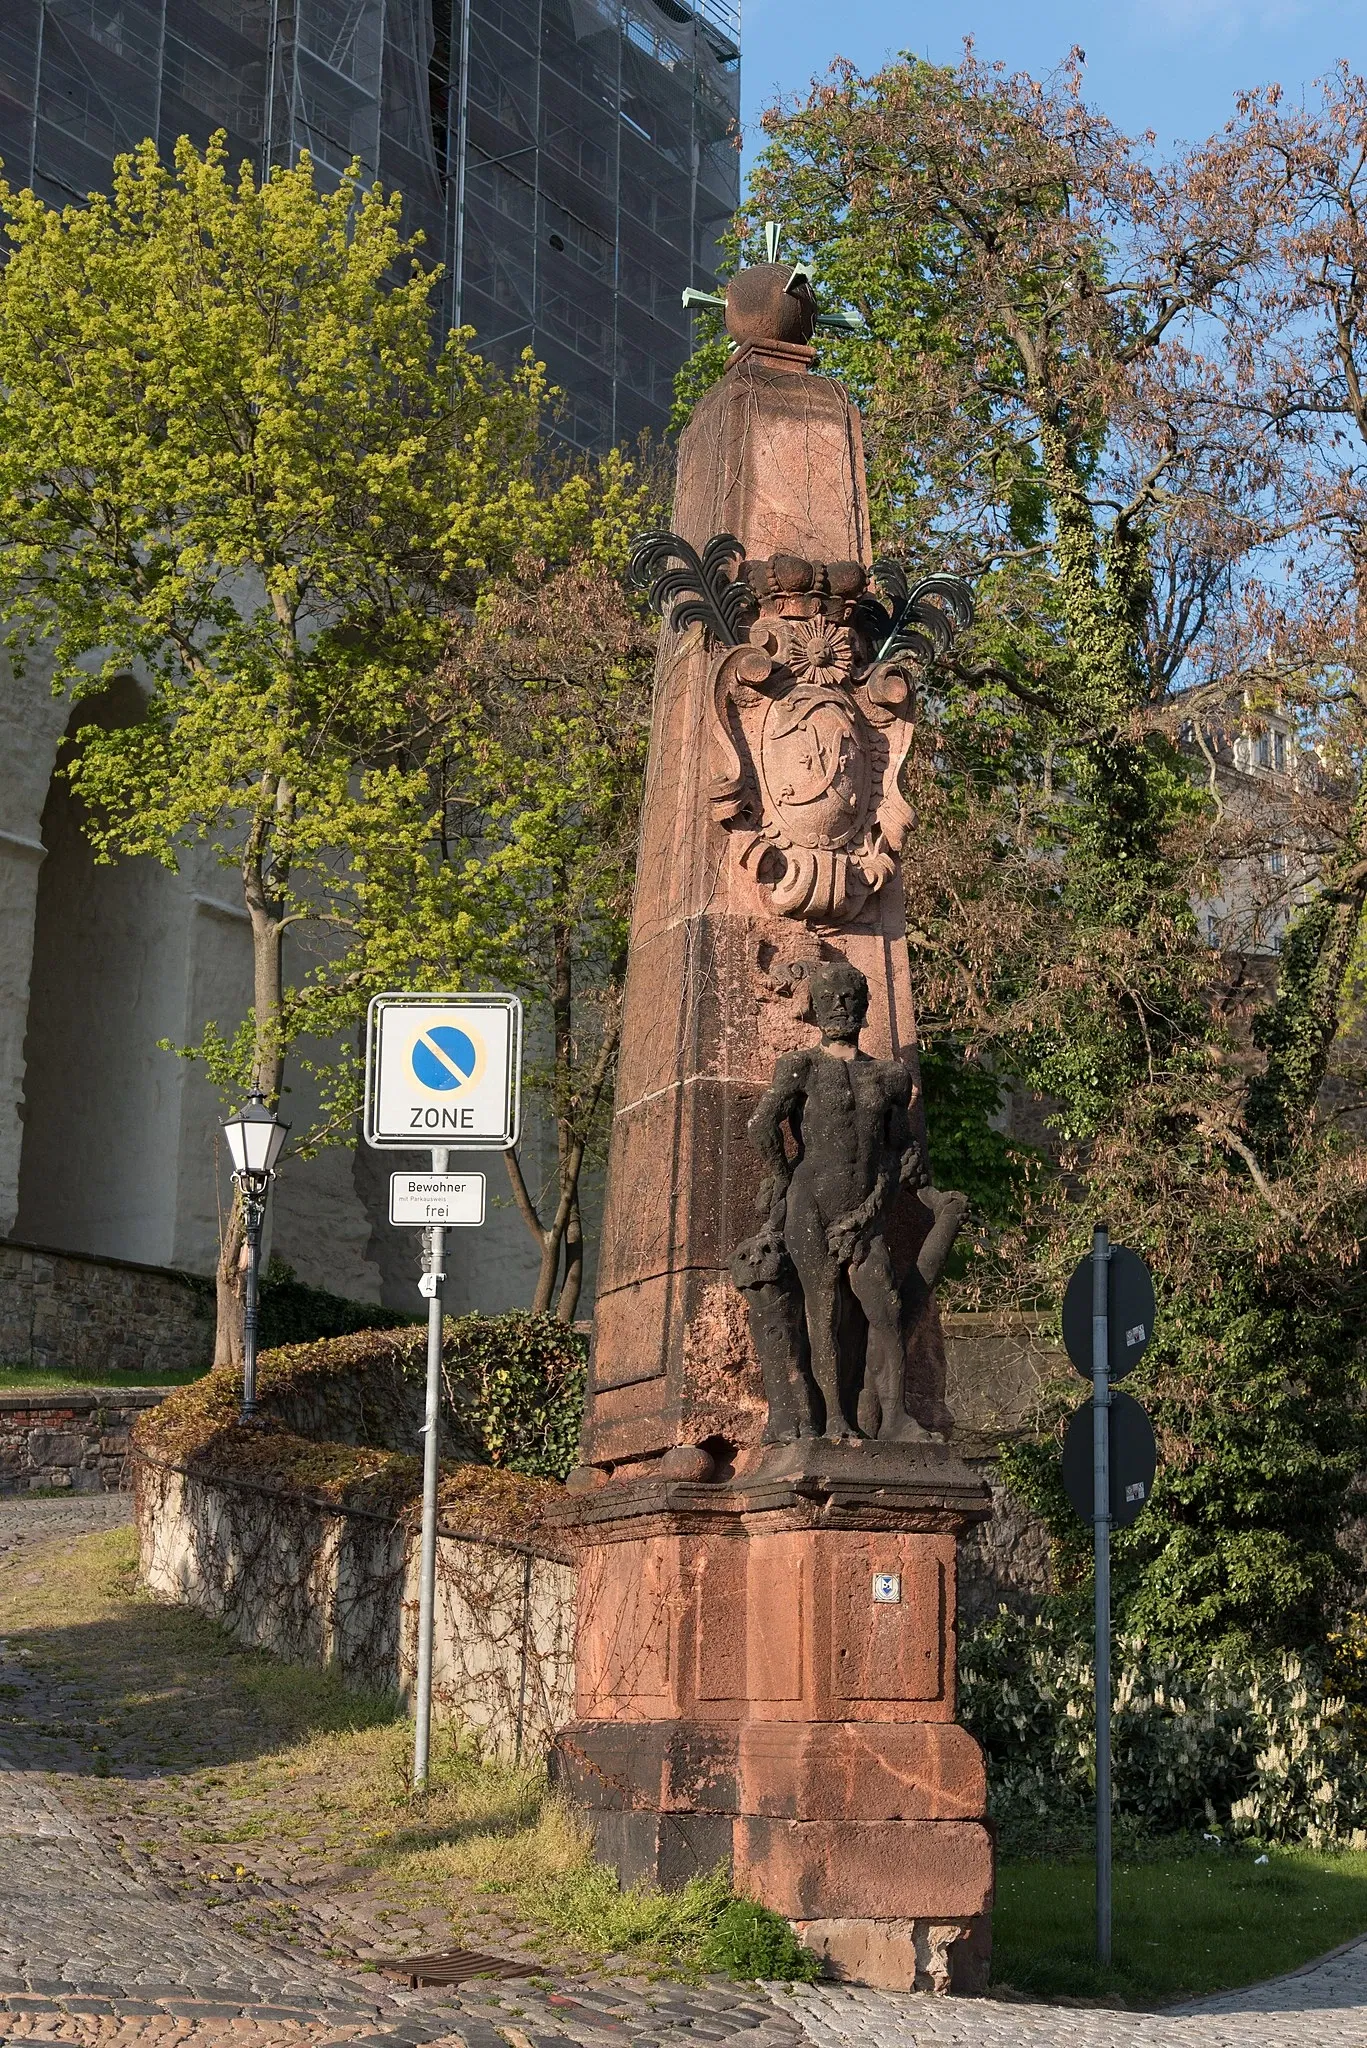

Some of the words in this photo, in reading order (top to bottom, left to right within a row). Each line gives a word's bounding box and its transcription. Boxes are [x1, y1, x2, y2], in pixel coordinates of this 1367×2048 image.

[410, 1108, 474, 1128] ZONE
[408, 1182, 466, 1192] Bewohner
[426, 1205, 449, 1217] frei
